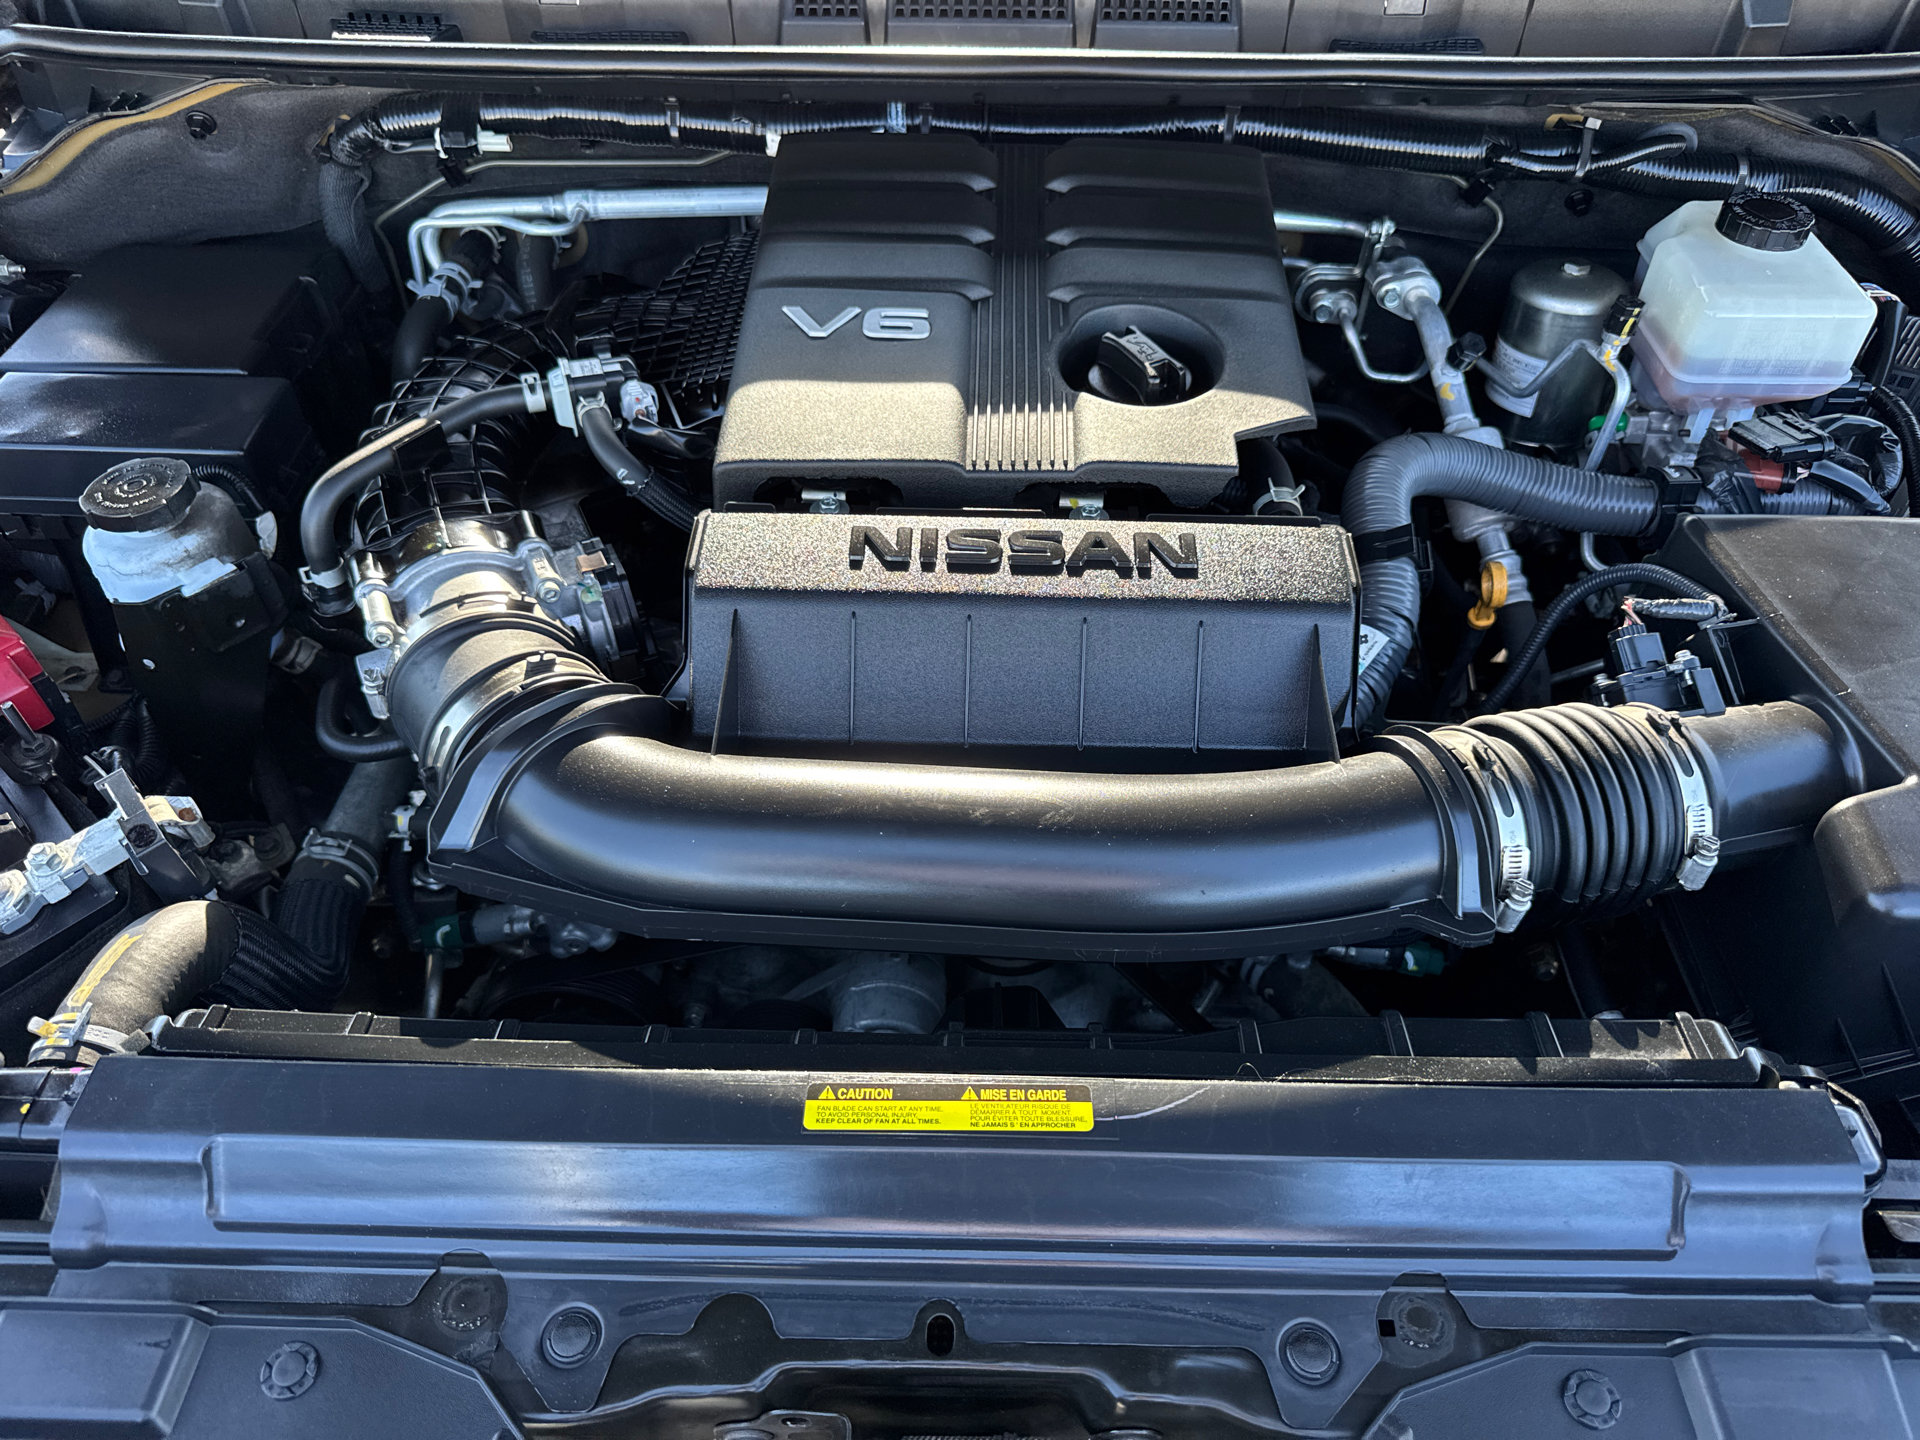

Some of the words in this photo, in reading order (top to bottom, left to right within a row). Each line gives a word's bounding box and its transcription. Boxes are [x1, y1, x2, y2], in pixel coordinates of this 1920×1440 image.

[782, 305, 931, 340] V6
[849, 525, 1198, 568] NISSAN
[837, 1088, 893, 1100] CAUTION
[980, 1089, 1007, 1100] MISE
[1009, 1089, 1025, 1100] EN
[1027, 1089, 1067, 1101] GARDE
